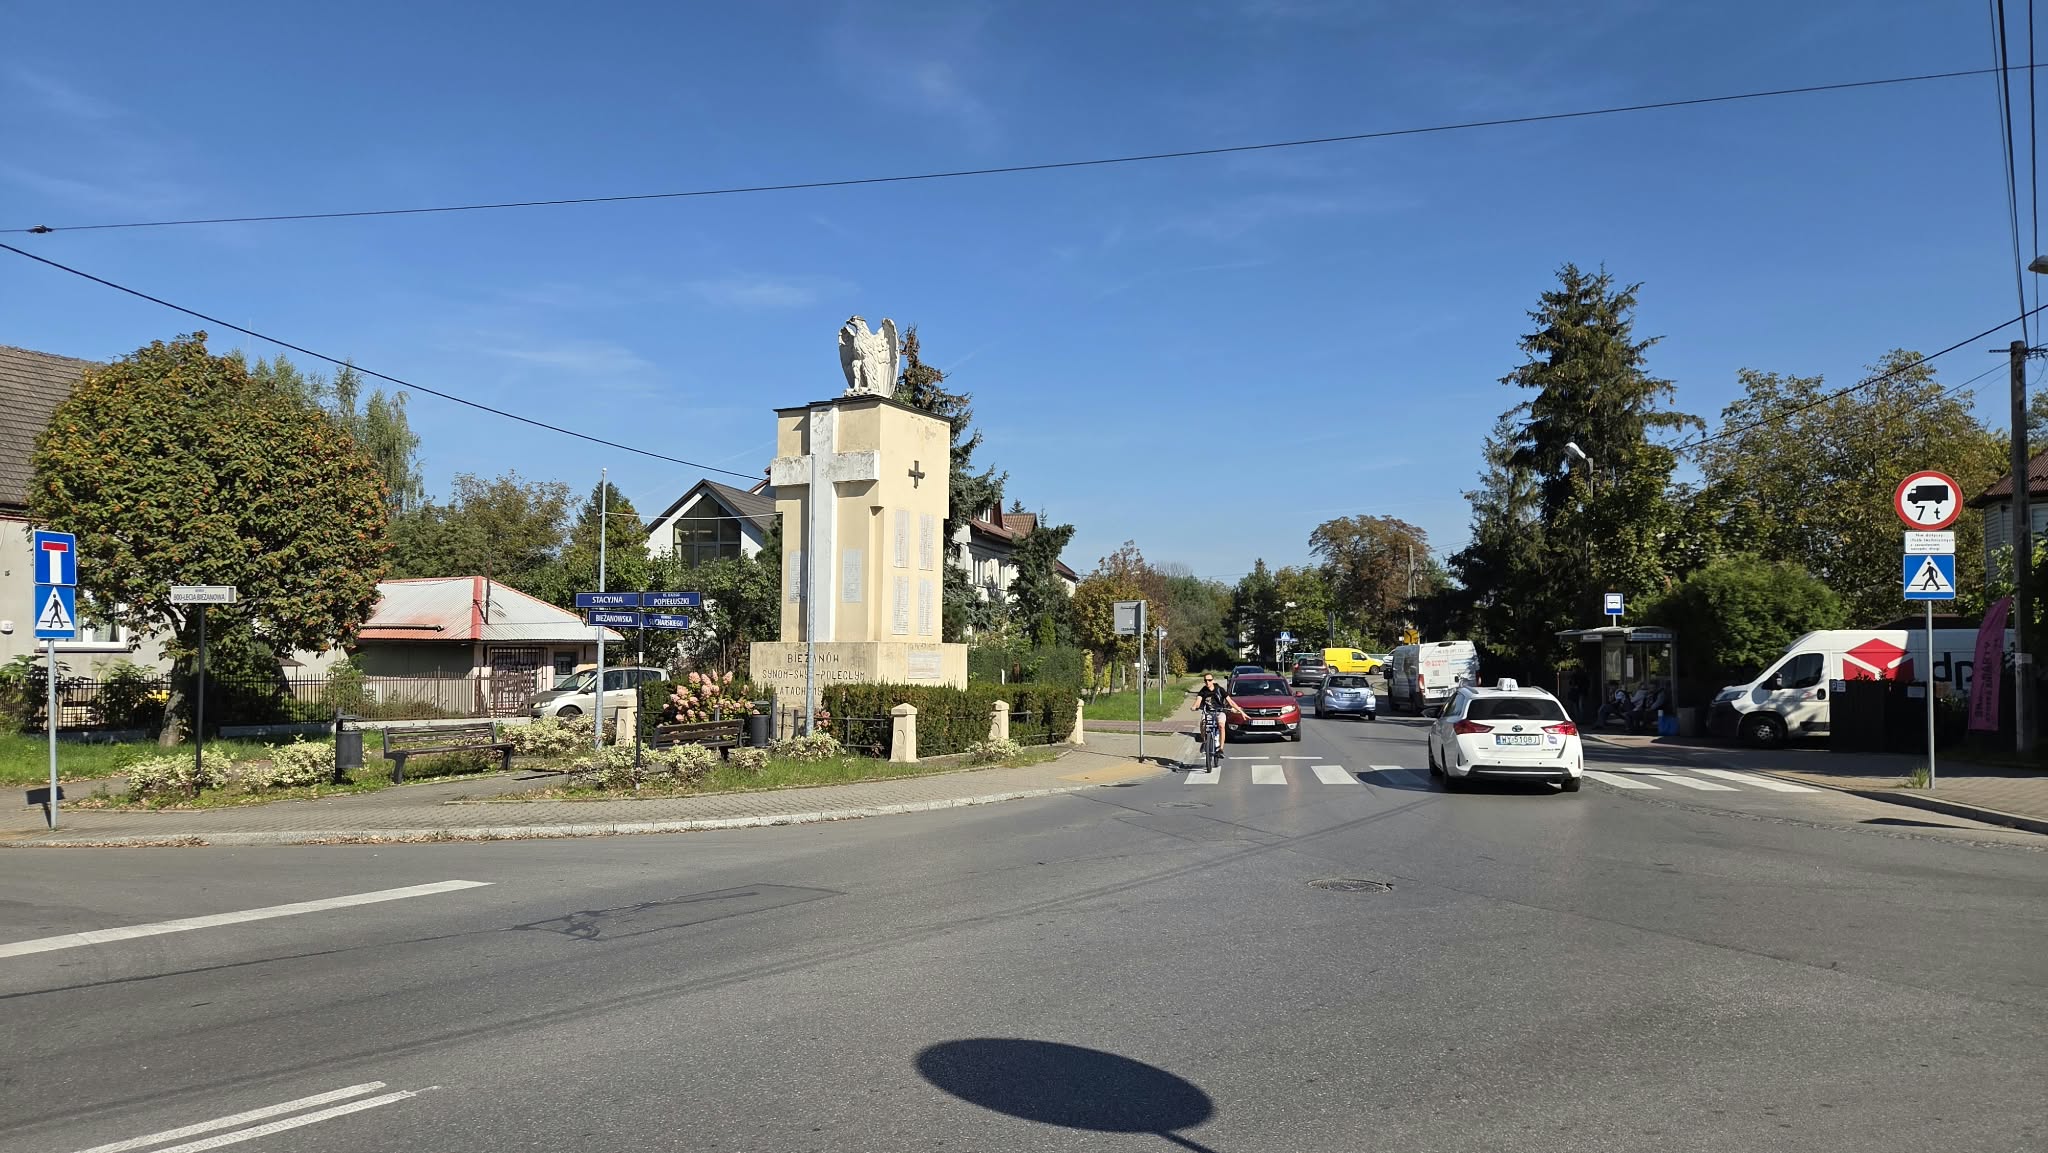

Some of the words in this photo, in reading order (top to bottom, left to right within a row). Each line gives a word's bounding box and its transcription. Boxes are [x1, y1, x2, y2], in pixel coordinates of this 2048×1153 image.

[1915, 505, 1925, 521] 7
[1934, 507, 1941, 520] t
[592, 596, 623, 604] STACYJNA
[653, 598, 690, 606] POPIEŁUSZKI
[595, 613, 633, 623] BIEŻANOWSKA
[648, 618, 684, 627] SUCHARSKIEGO
[1932, 651, 1975, 690] dp
